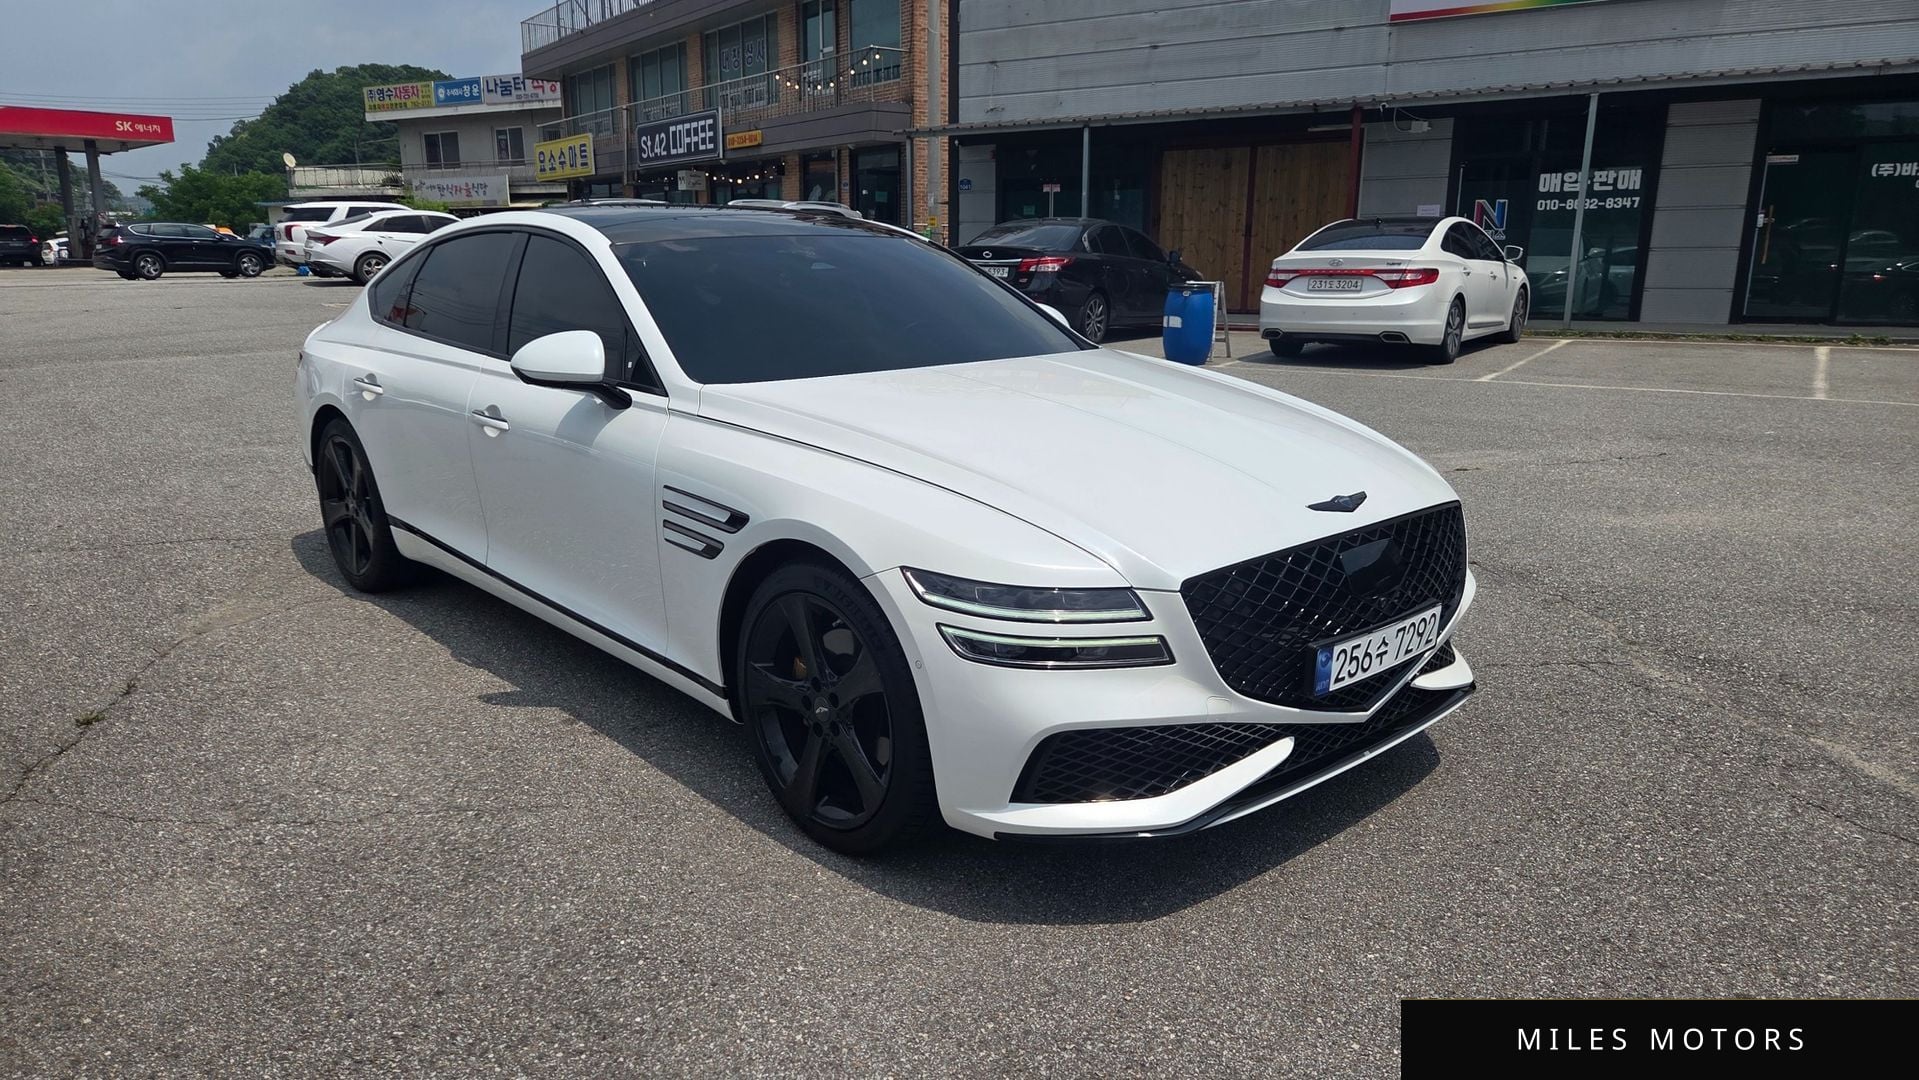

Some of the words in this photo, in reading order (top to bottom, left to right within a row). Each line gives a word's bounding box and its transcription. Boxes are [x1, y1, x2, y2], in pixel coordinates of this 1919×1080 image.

[485, 77, 526, 96] 나눔터
[115, 120, 133, 132] SK
[134, 123, 161, 133] 에너지
[641, 132, 667, 159] St.42
[669, 119, 714, 155] COFFEE
[538, 142, 590, 174] 요소수마트
[1871, 162, 1919, 177] (주)바
[1335, 280, 1359, 289] 3204
[1333, 635, 1389, 685] 256수
[1394, 612, 1437, 661] 7292
